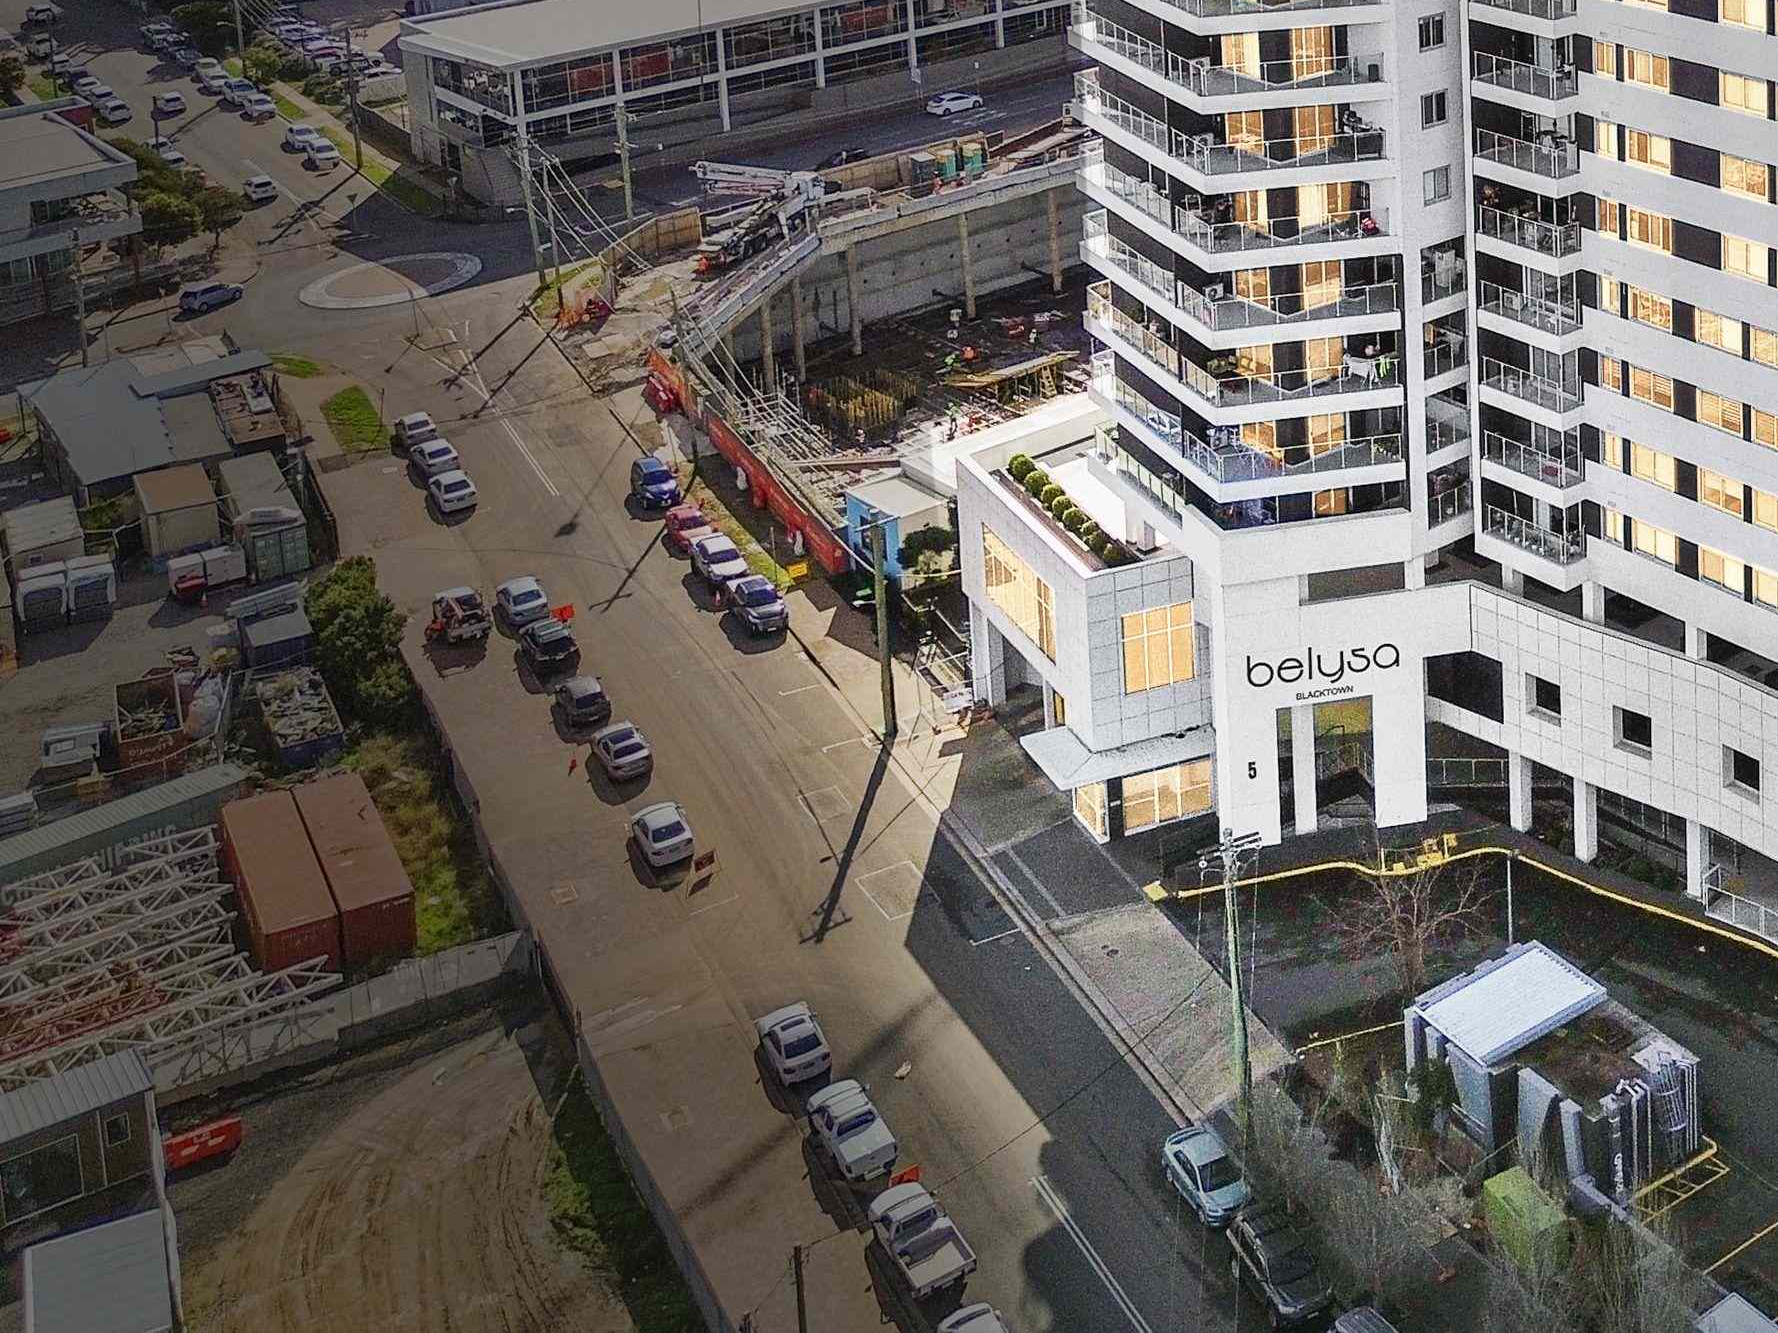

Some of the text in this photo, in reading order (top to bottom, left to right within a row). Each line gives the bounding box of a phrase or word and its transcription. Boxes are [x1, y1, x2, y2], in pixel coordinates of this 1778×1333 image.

[1247, 643, 1400, 687] belysa
[1296, 685, 1354, 701] BLACKTOWN
[1248, 761, 1257, 779] 5
